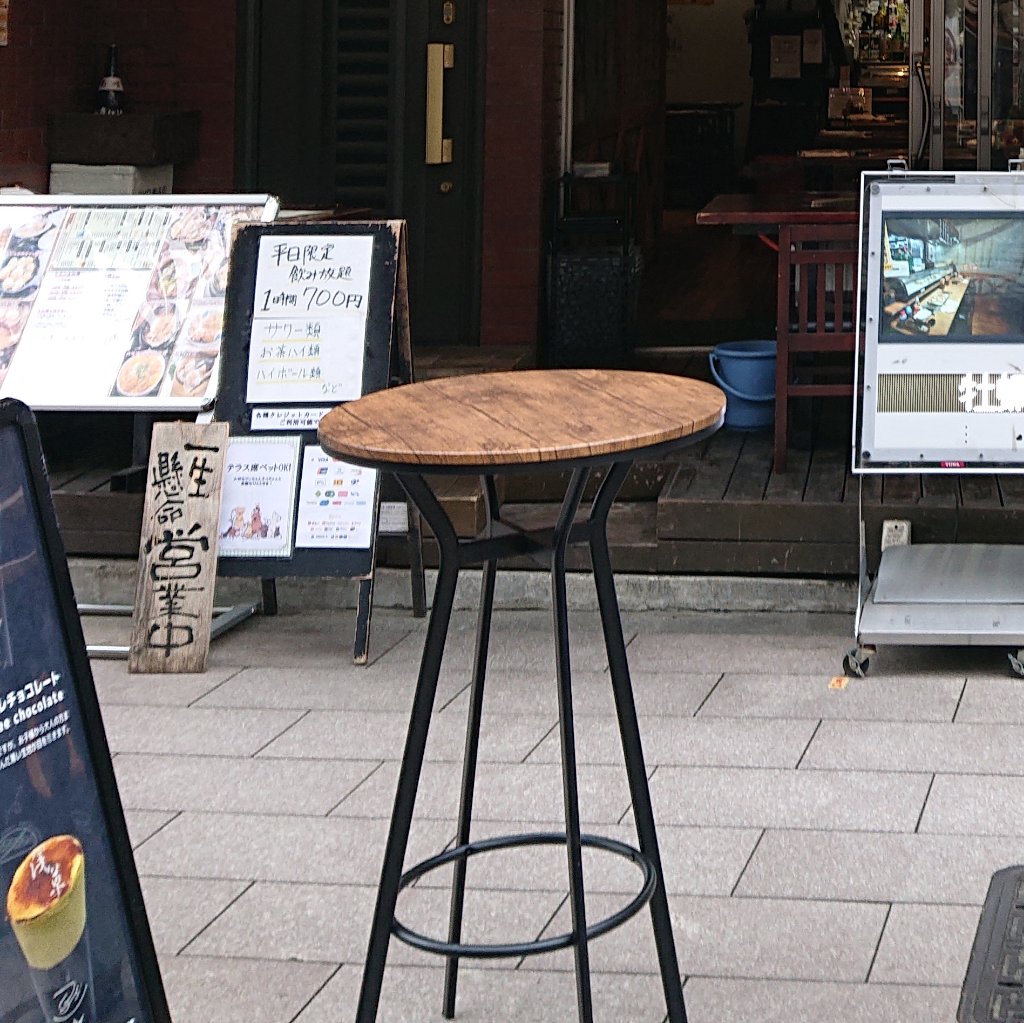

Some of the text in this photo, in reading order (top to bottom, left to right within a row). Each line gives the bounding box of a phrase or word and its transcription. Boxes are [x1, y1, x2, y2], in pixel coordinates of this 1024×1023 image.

[271, 242, 335, 267] 平日限定
[289, 265, 353, 284] 飲み放題
[260, 286, 363, 312] 1時間 700円
[264, 322, 321, 339] サワー類
[145, 523, 210, 657] 営業中
[13, 690, 65, 726] chocolate
